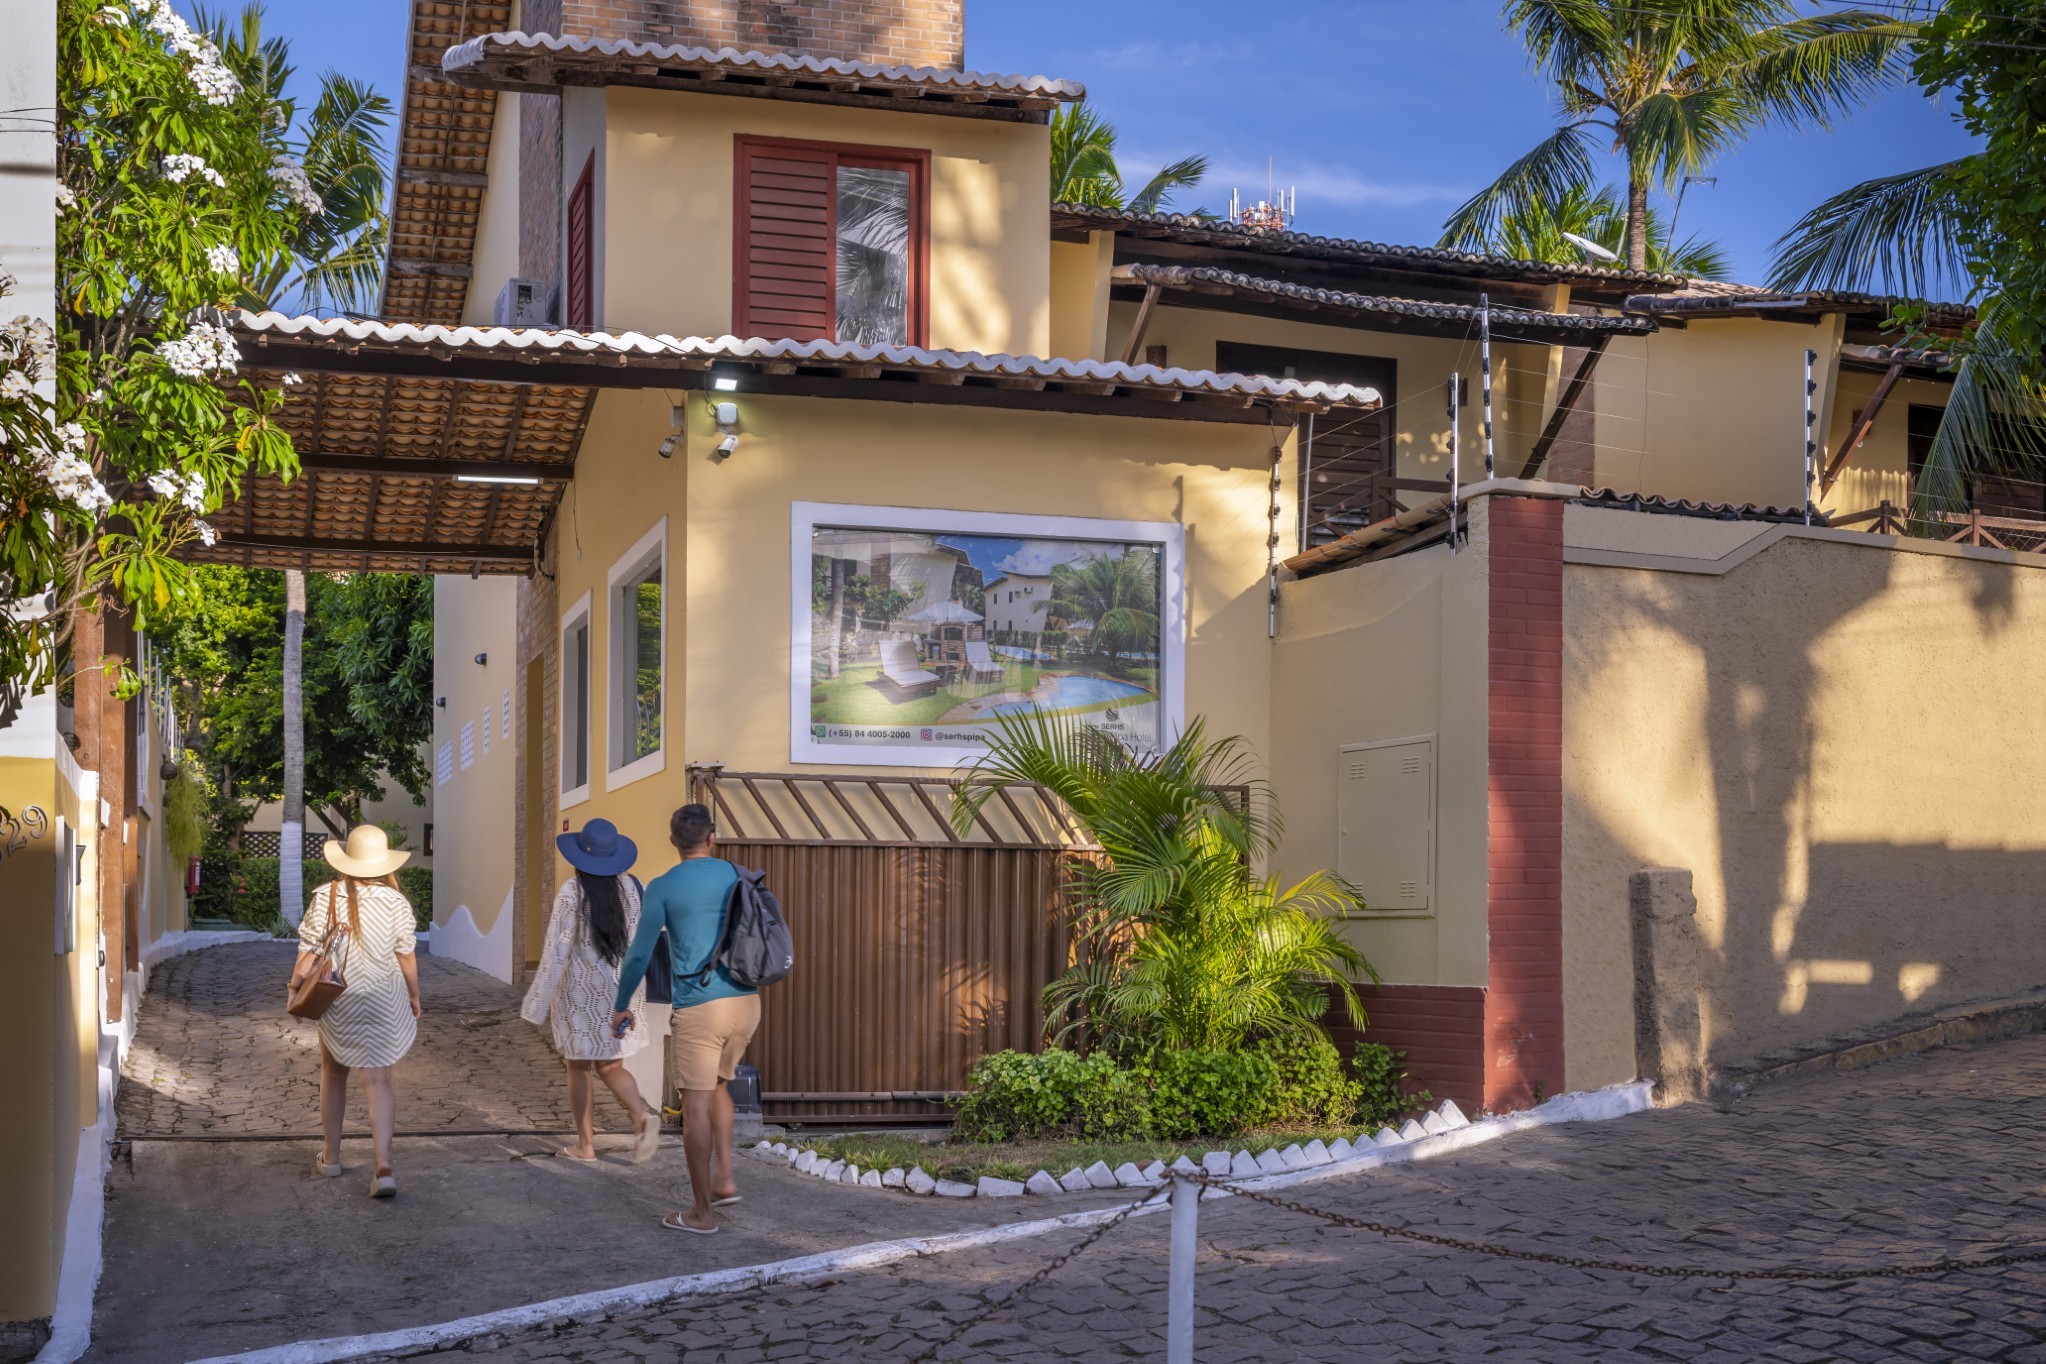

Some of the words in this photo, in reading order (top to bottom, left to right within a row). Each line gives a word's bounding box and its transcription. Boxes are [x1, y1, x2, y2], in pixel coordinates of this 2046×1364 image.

[1101, 723, 1125, 731] SERHS
[828, 729, 852, 739] (+55)
[855, 730, 865, 738] 84
[867, 730, 911, 739] 4005-2000
[935, 732, 985, 742] @serhspipa
[1130, 732, 1152, 742] Hotel
[0, 805, 48, 863] 29
